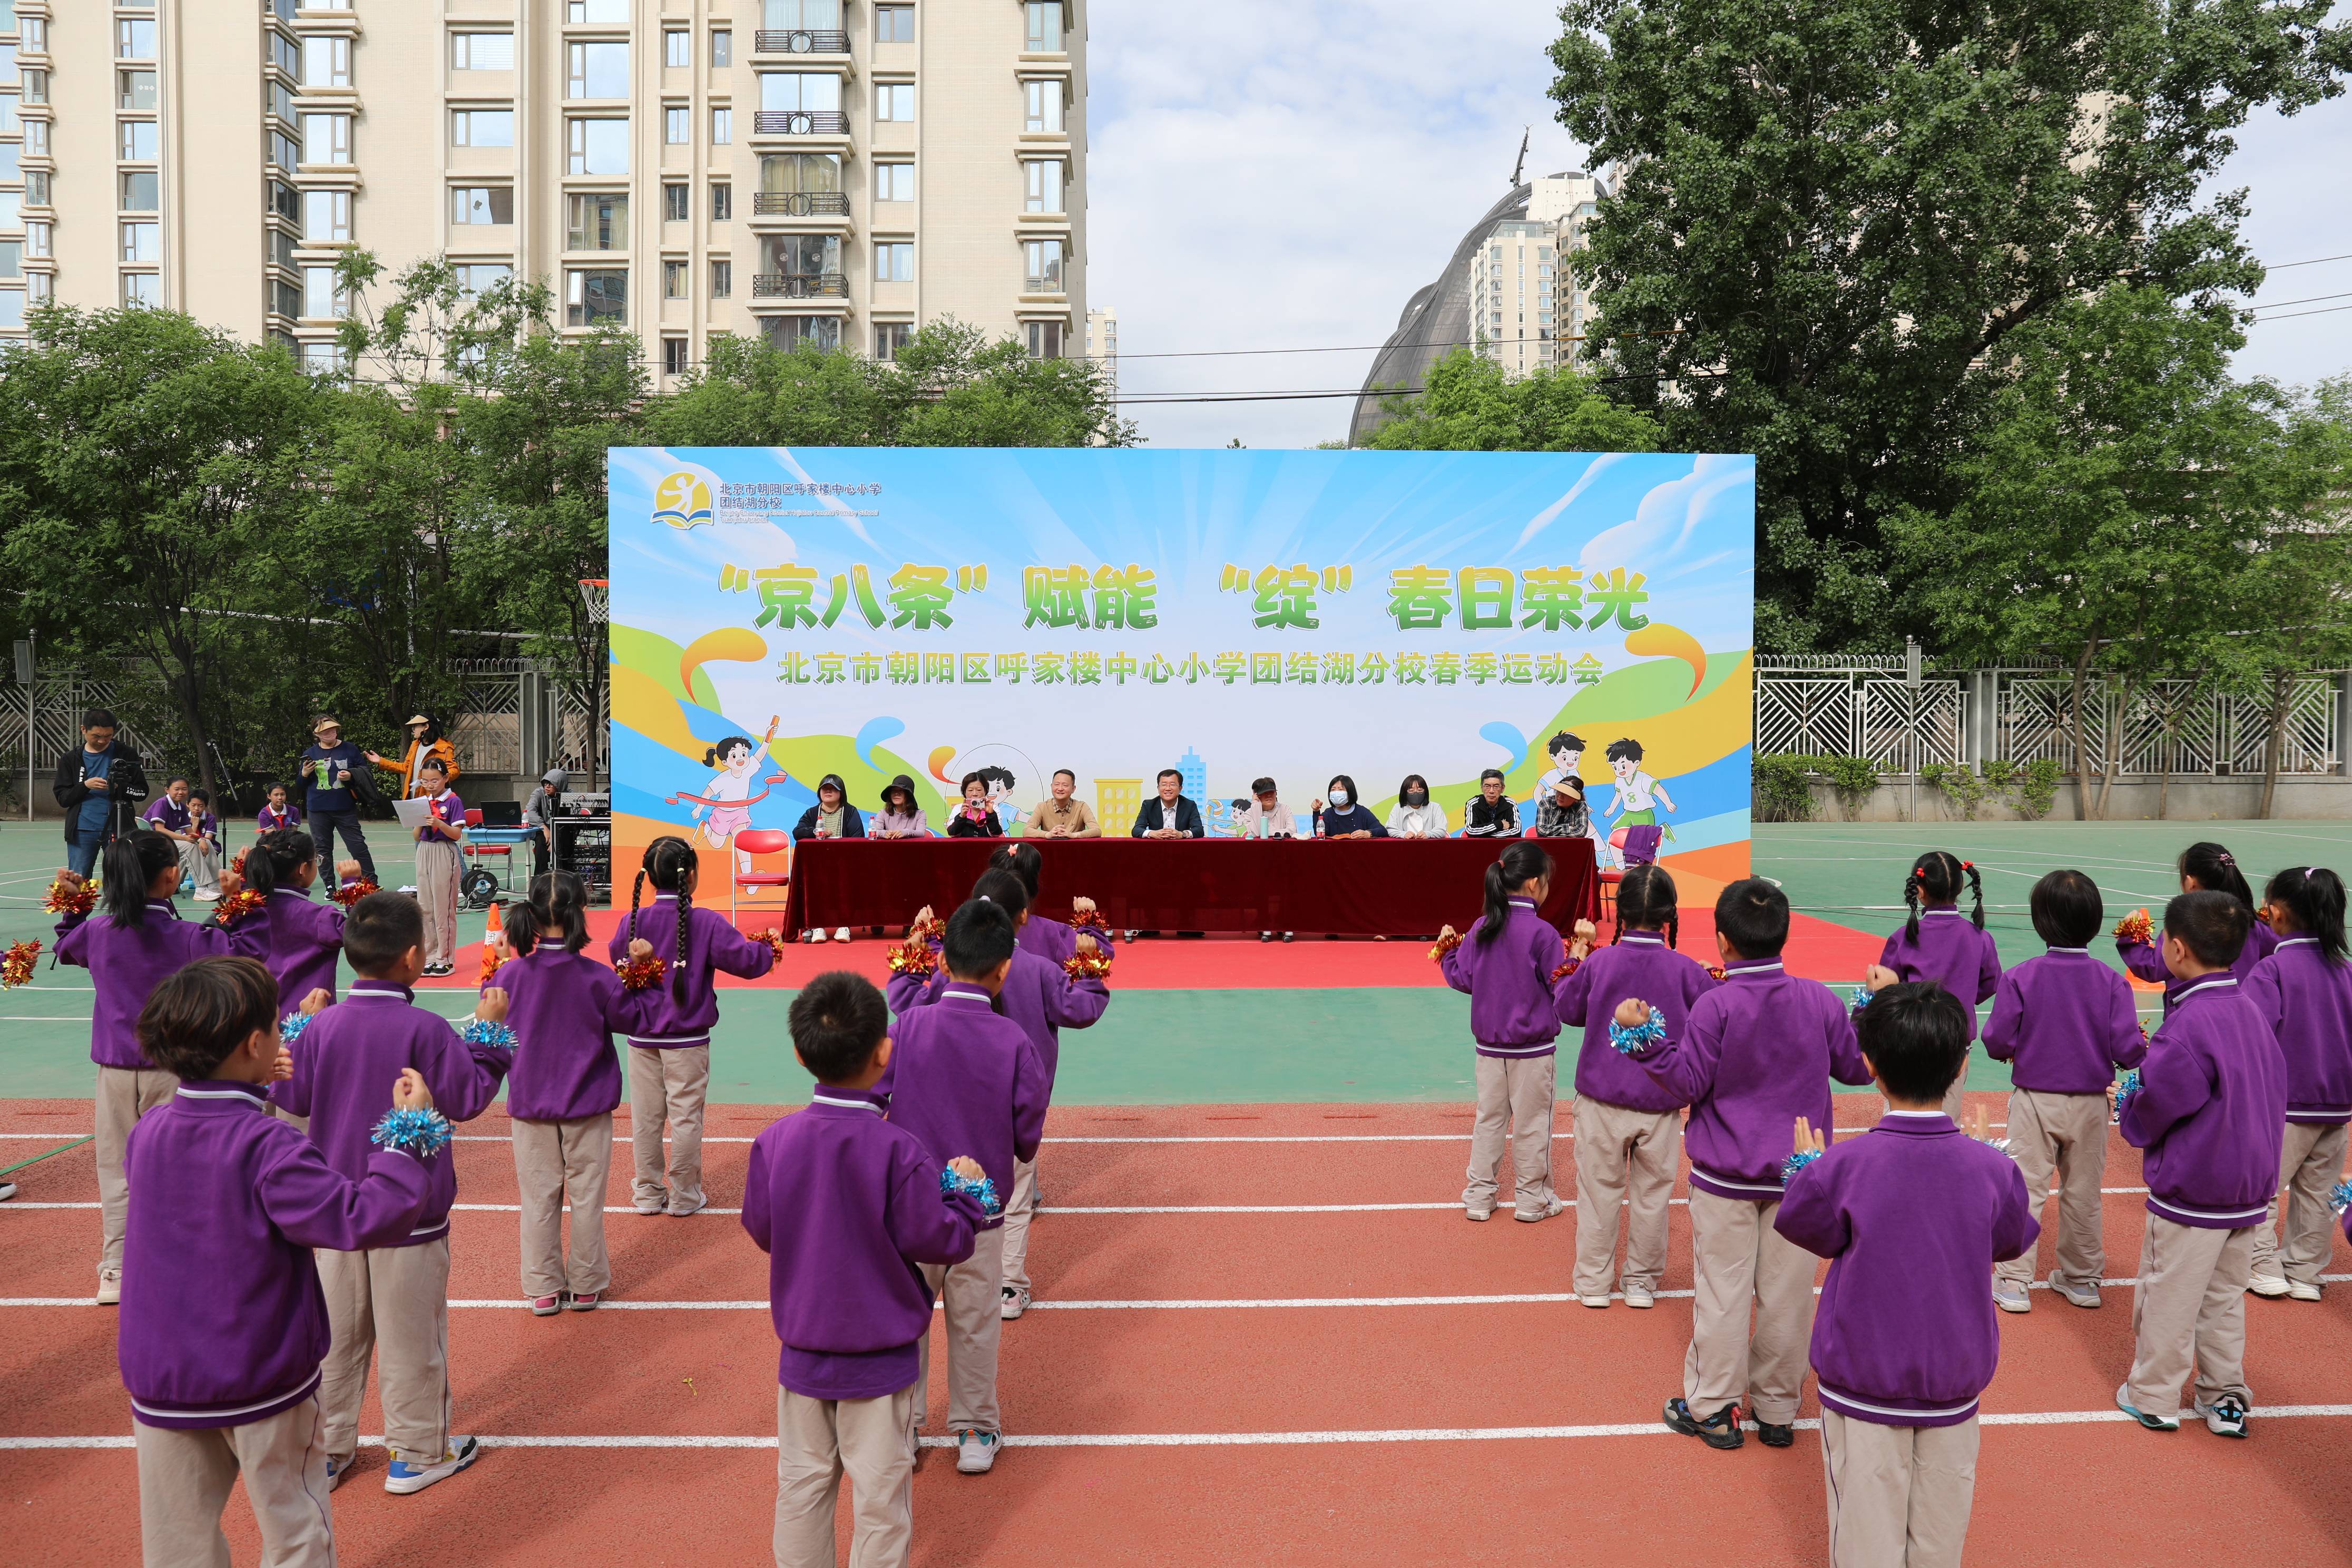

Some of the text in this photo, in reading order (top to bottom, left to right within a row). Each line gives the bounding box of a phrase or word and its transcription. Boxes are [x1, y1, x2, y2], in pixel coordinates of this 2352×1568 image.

[720, 483, 881, 495] 北京市朝阳区呼家楼中心小学
[720, 497, 781, 508] 团结湖分校
[1022, 564, 1159, 631] 赋能
[1387, 565, 1651, 631] 春日荣光
[778, 651, 1604, 685] 北京市朝阳区呼家楼中心小学团结湖分校春季运动会
